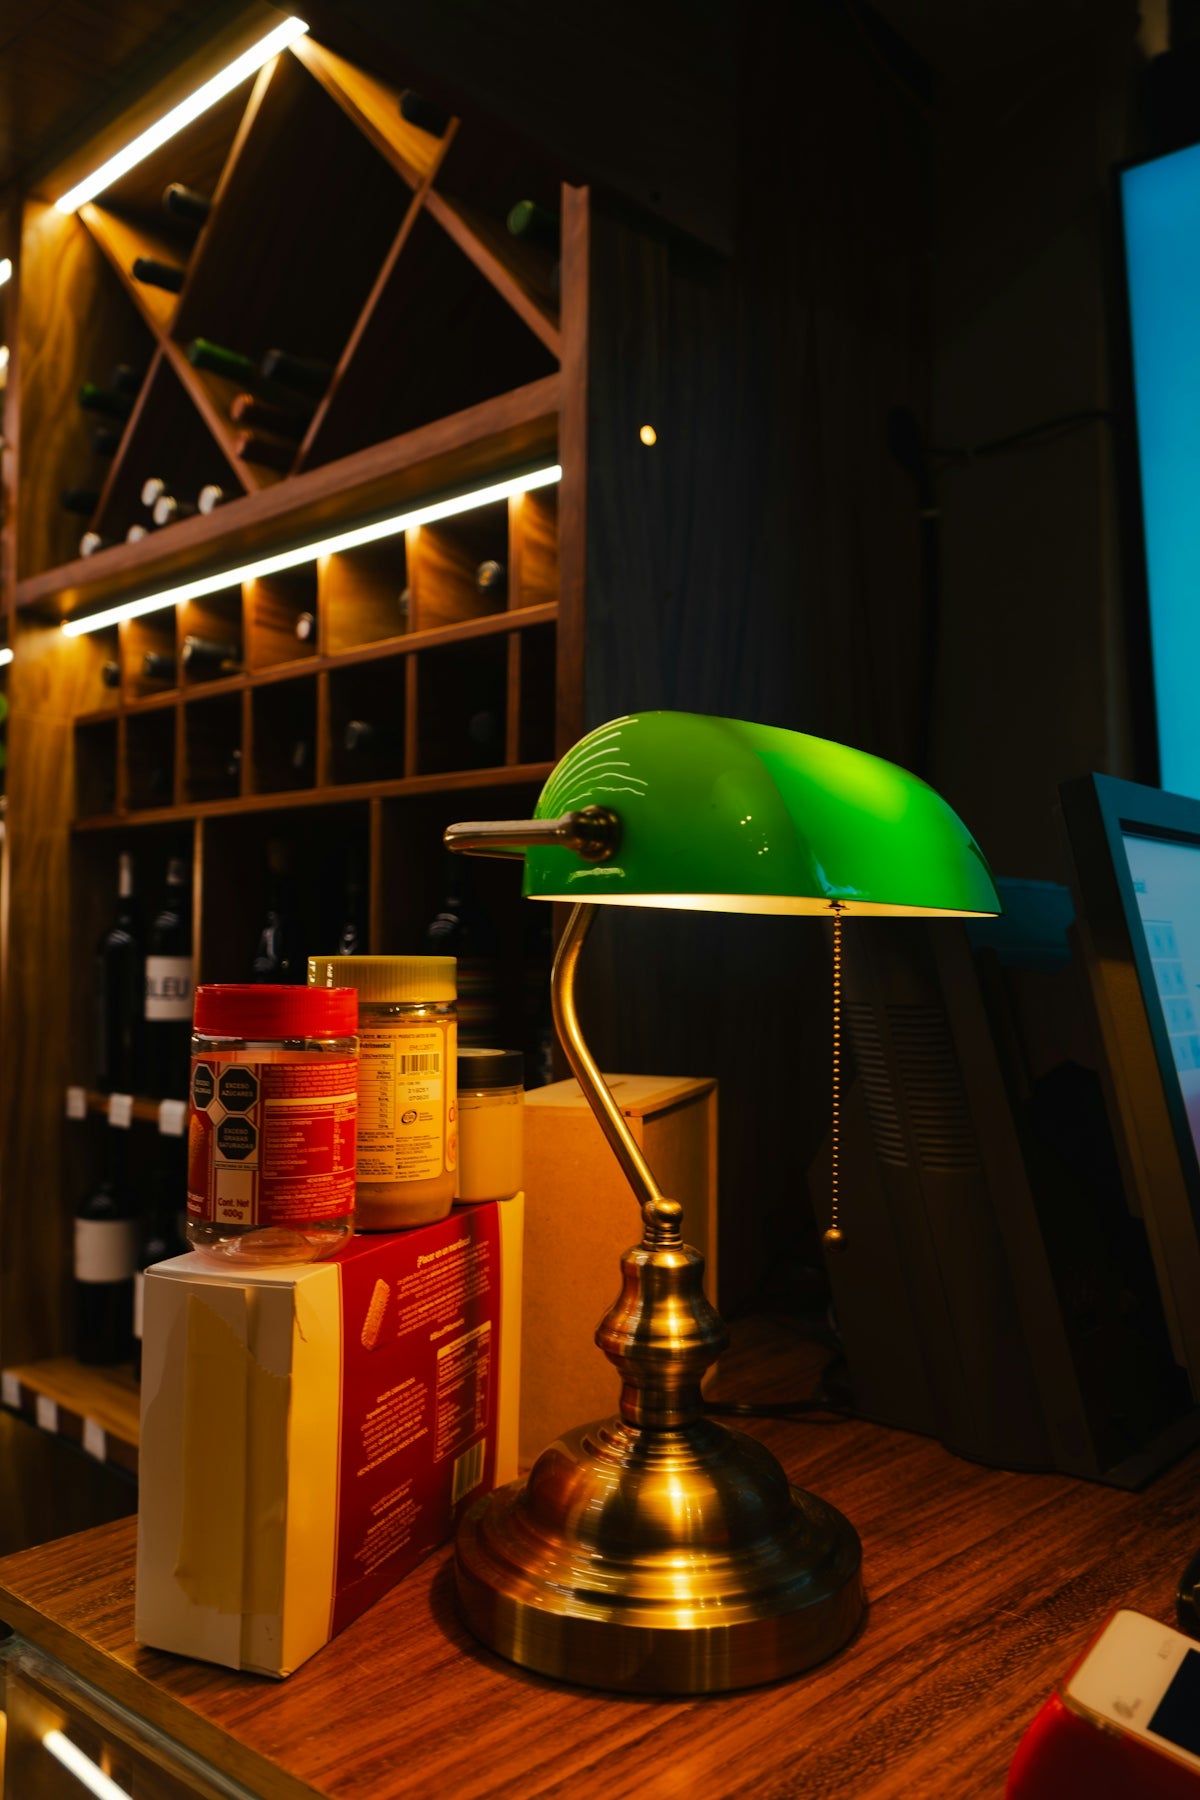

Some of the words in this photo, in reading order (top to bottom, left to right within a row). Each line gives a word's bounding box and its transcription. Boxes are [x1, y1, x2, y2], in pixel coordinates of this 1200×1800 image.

[218, 1197, 236, 1207] Cont.
[237, 1199, 250, 1208] Net
[222, 1208, 244, 1221] 400g
